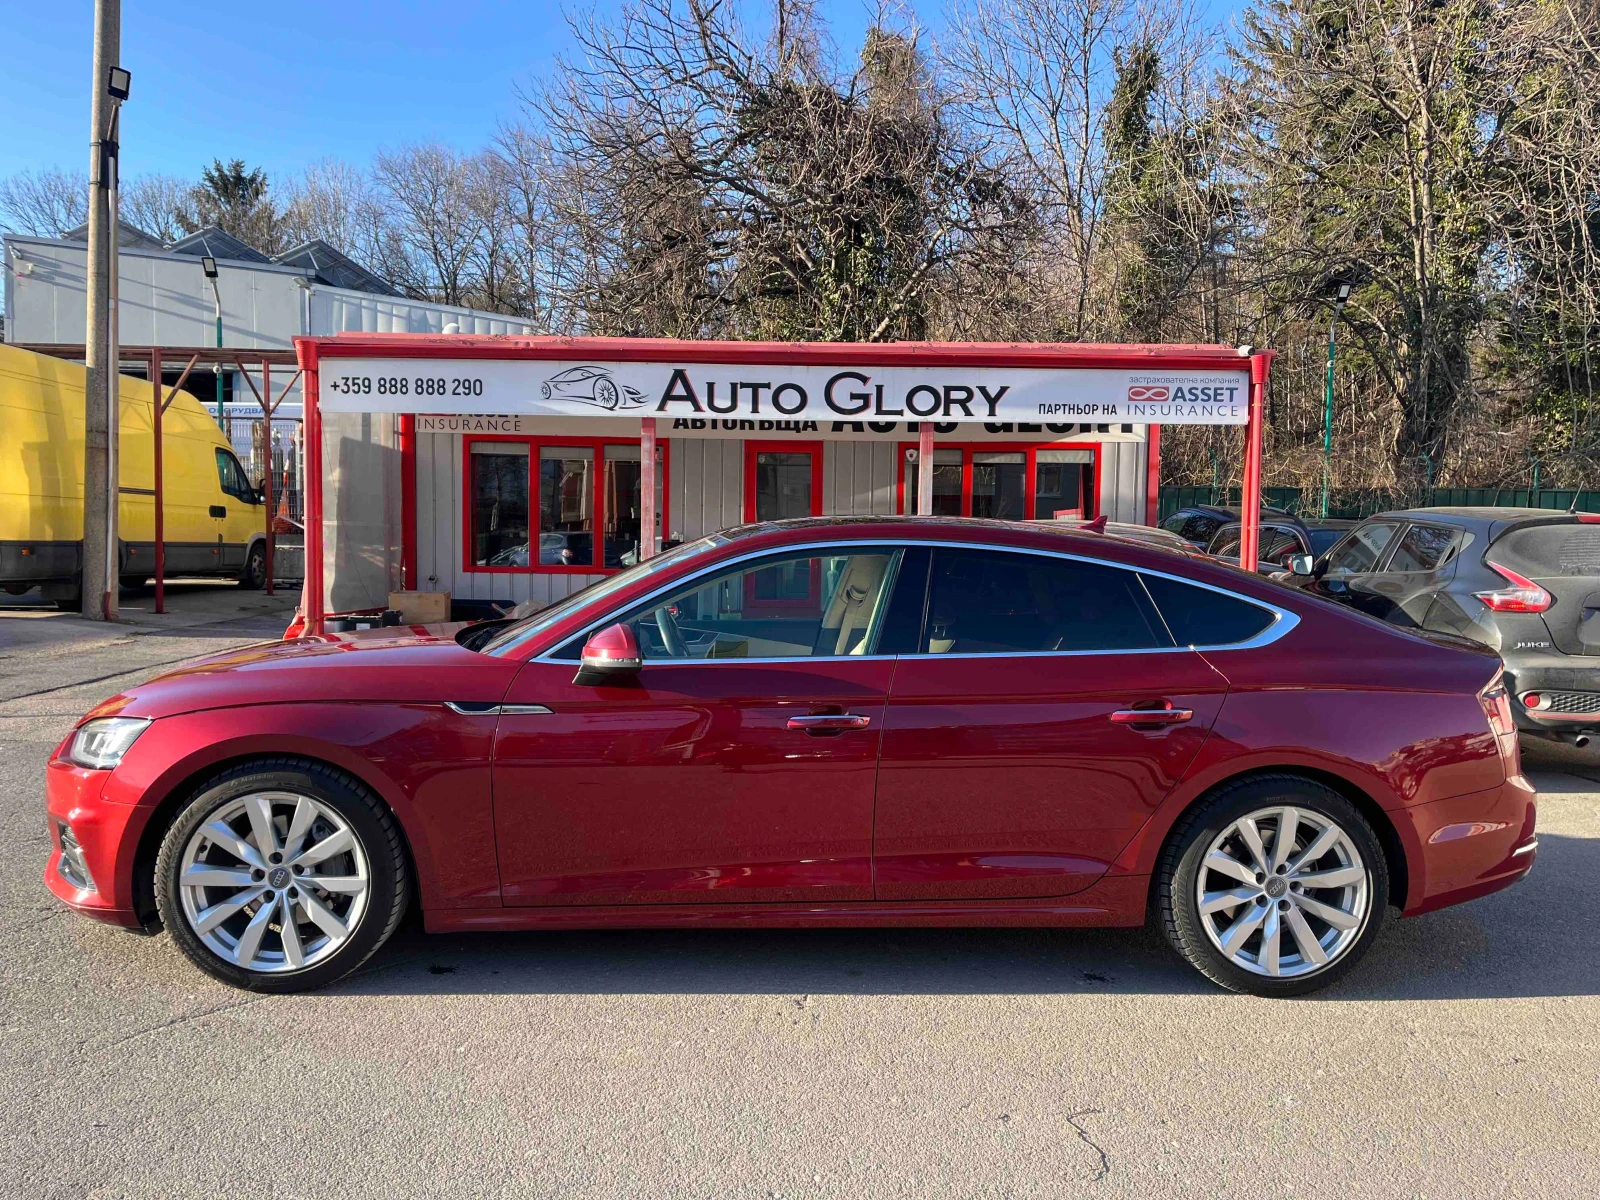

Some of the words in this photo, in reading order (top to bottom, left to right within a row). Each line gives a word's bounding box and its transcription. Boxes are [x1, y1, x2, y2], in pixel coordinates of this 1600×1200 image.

[330, 377, 372, 395] +359
[377, 377, 409, 395] 888
[414, 378, 447, 396] 888
[451, 378, 483, 396] 290
[1129, 376, 1198, 385] застрахователна
[1199, 377, 1240, 385] компания
[655, 368, 808, 415] AUTO
[823, 371, 1011, 417] GLORY
[1171, 386, 1239, 402] ASSET
[1038, 403, 1099, 415] ПАРТНЬОР
[1102, 404, 1118, 415] НА
[1127, 404, 1239, 417] INSURANCE
[417, 418, 521, 431] INSURANCE
[1513, 641, 1551, 649] JUKE
